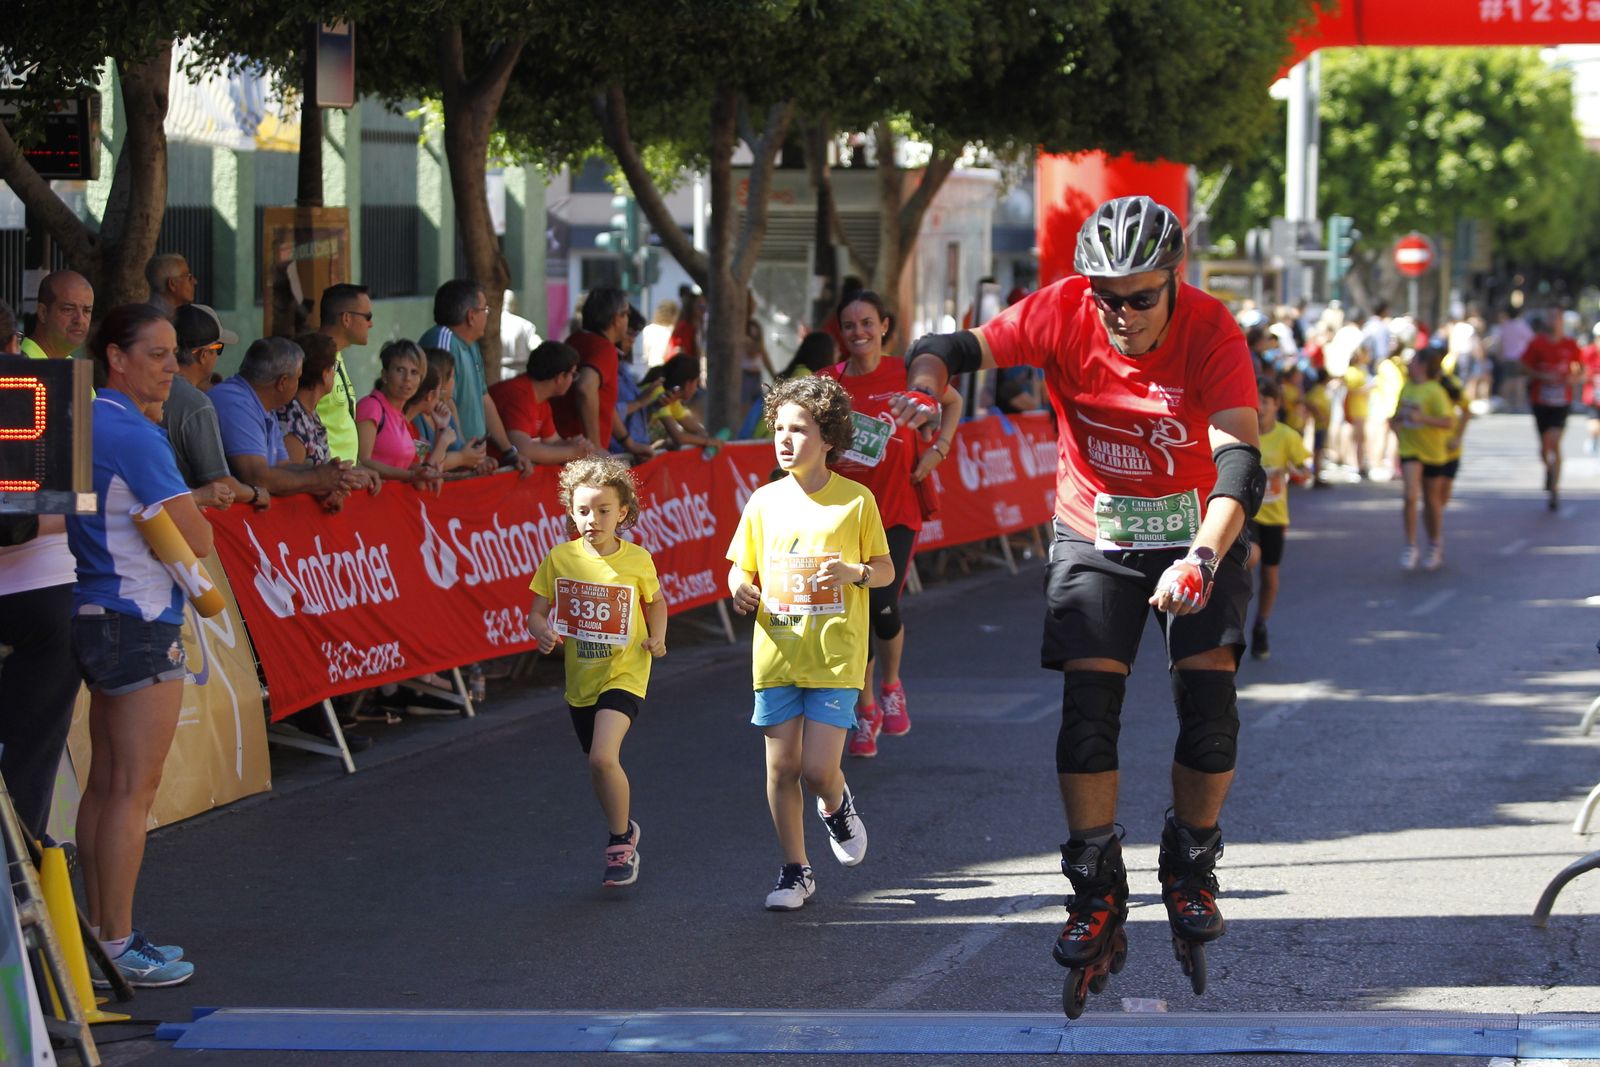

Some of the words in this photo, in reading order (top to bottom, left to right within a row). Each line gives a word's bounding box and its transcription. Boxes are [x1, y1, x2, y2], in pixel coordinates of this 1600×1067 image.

[1088, 435, 1148, 459] CARRERA
[1088, 448, 1152, 470] SOLIDARIA
[1117, 499, 1127, 513] 6
[1131, 500, 1168, 508] CARRERA
[1112, 514, 1184, 533] 1288
[1134, 533, 1167, 541] ENRIQUE
[278, 531, 400, 616] Santander
[571, 582, 578, 595] 6
[782, 574, 828, 593] 131
[793, 594, 812, 603] JORGE
[569, 598, 611, 621] 336
[578, 619, 602, 630] CLAUDIA
